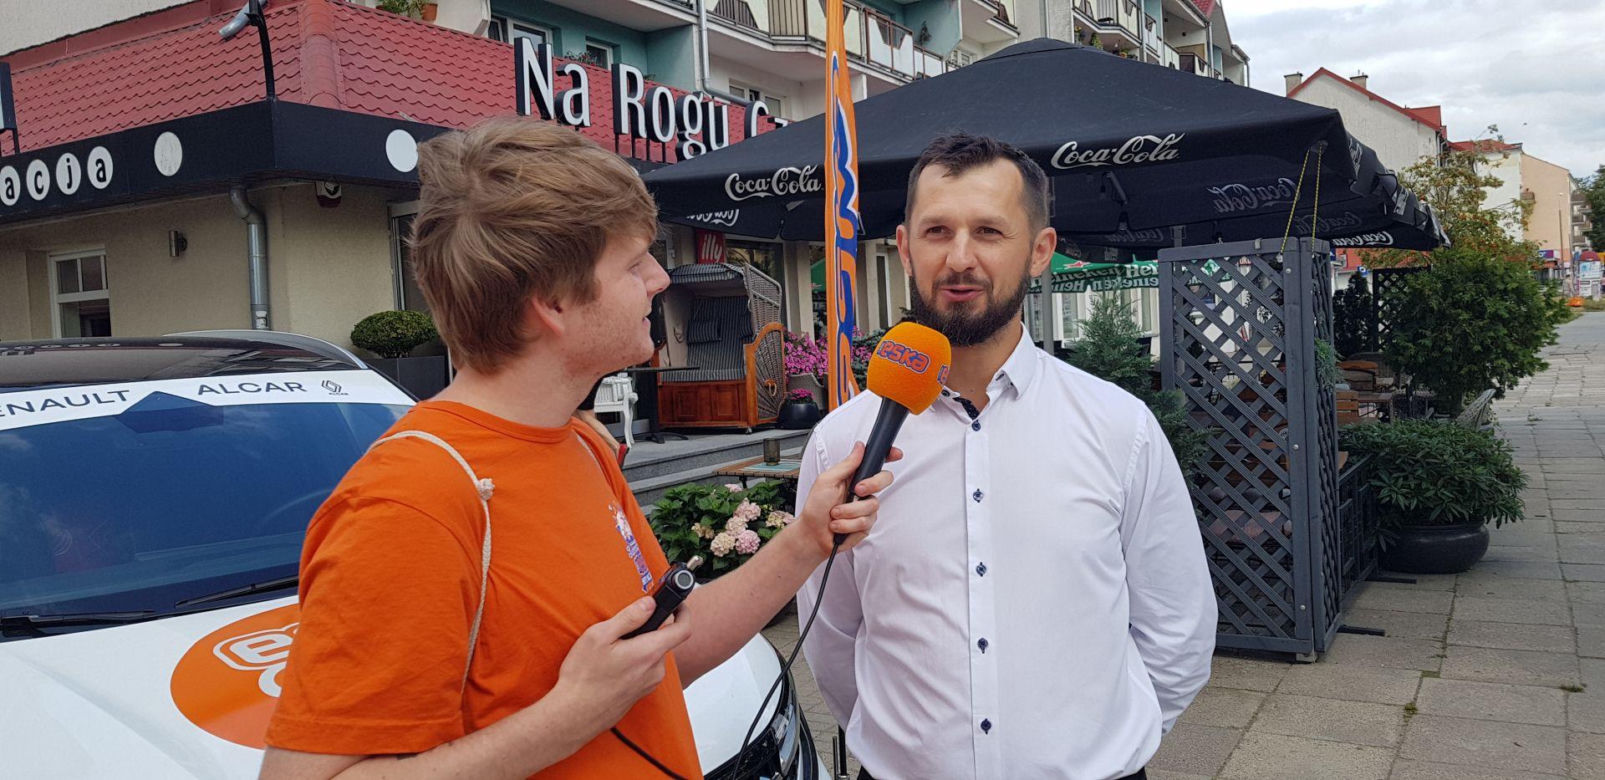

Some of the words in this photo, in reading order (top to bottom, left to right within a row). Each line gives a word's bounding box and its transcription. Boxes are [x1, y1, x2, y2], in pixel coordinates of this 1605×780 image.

[515, 37, 591, 127] Na
[612, 63, 729, 160] Rogu
[1051, 133, 1185, 169] Coca-Cola
[725, 165, 822, 201] Coca-Cola
[702, 233, 722, 262] illy
[0, 389, 130, 417] NAULT
[198, 382, 308, 396] ALCAR
